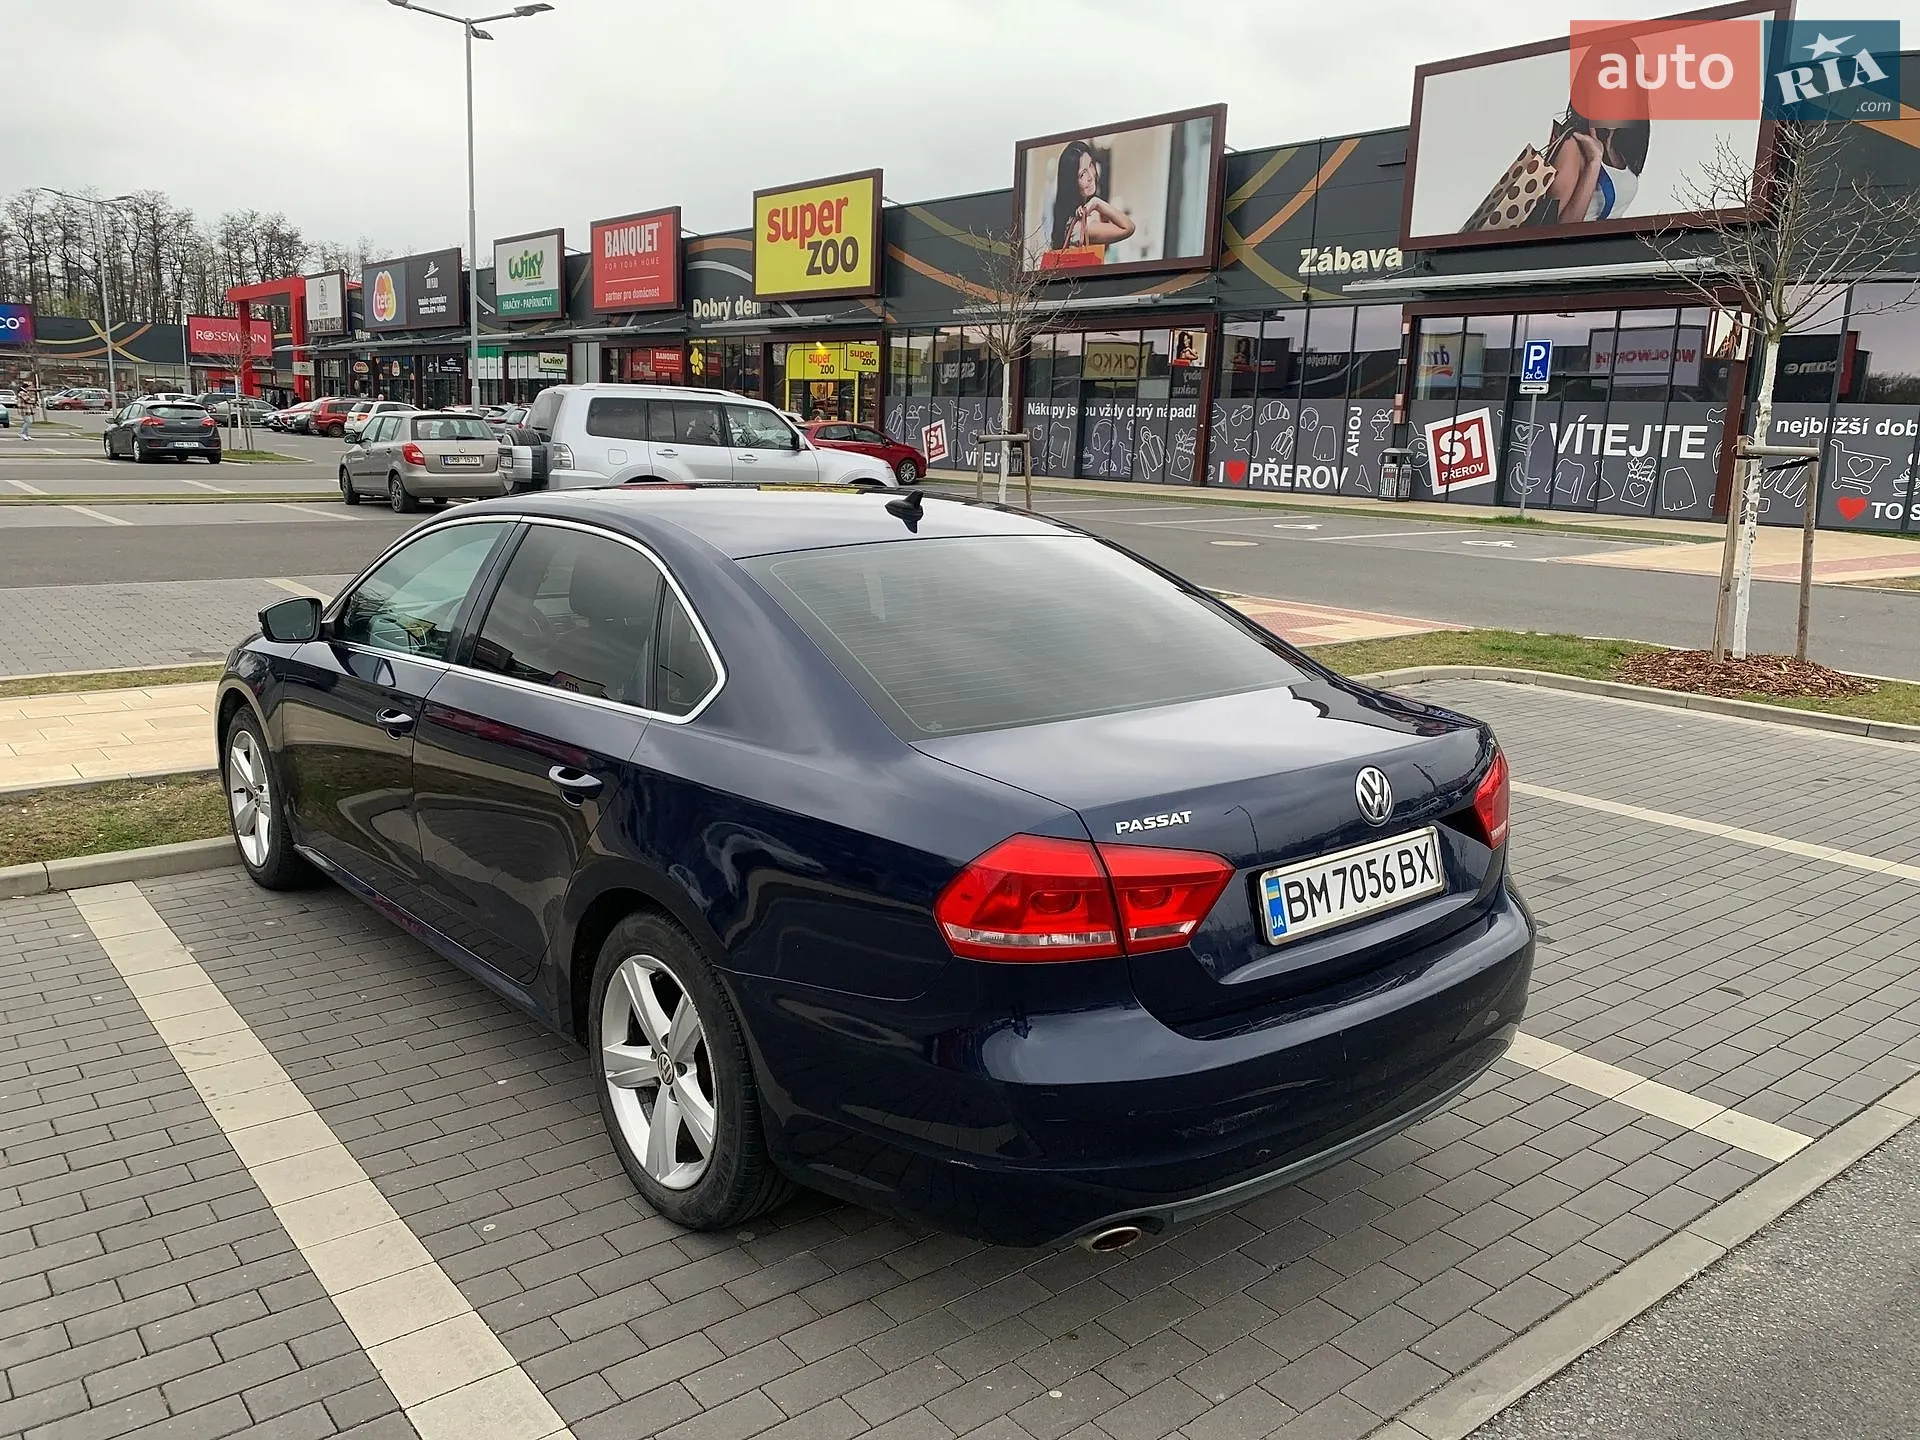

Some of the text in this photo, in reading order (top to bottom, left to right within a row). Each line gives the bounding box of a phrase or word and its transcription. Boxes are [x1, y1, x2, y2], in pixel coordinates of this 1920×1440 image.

[767, 197, 849, 249] super
[604, 222, 659, 258] BANQUET
[604, 256, 660, 272] FOR YOUR HOME
[1298, 246, 1403, 273] Zábava
[605, 286, 660, 303] partner pro domácnost
[693, 295, 732, 321] Dobrý
[195, 330, 267, 344] ROSSMNN
[808, 352, 832, 366] super
[849, 349, 874, 360] super
[1528, 345, 1546, 370] P
[1027, 402, 1065, 419] Nákupy
[1099, 403, 1124, 420] vždy
[1346, 406, 1363, 457] AHOJ
[1549, 414, 1709, 460] VÍTEJTE
[1775, 417, 1871, 438] nejbližší
[1439, 423, 1483, 465] S1
[1248, 457, 1349, 490] PŘEROV
[1441, 462, 1485, 482] PŘEROV
[1871, 501, 1904, 520] TO
[1114, 810, 1192, 835] PASSAT
[1332, 854, 1397, 910] 7056
